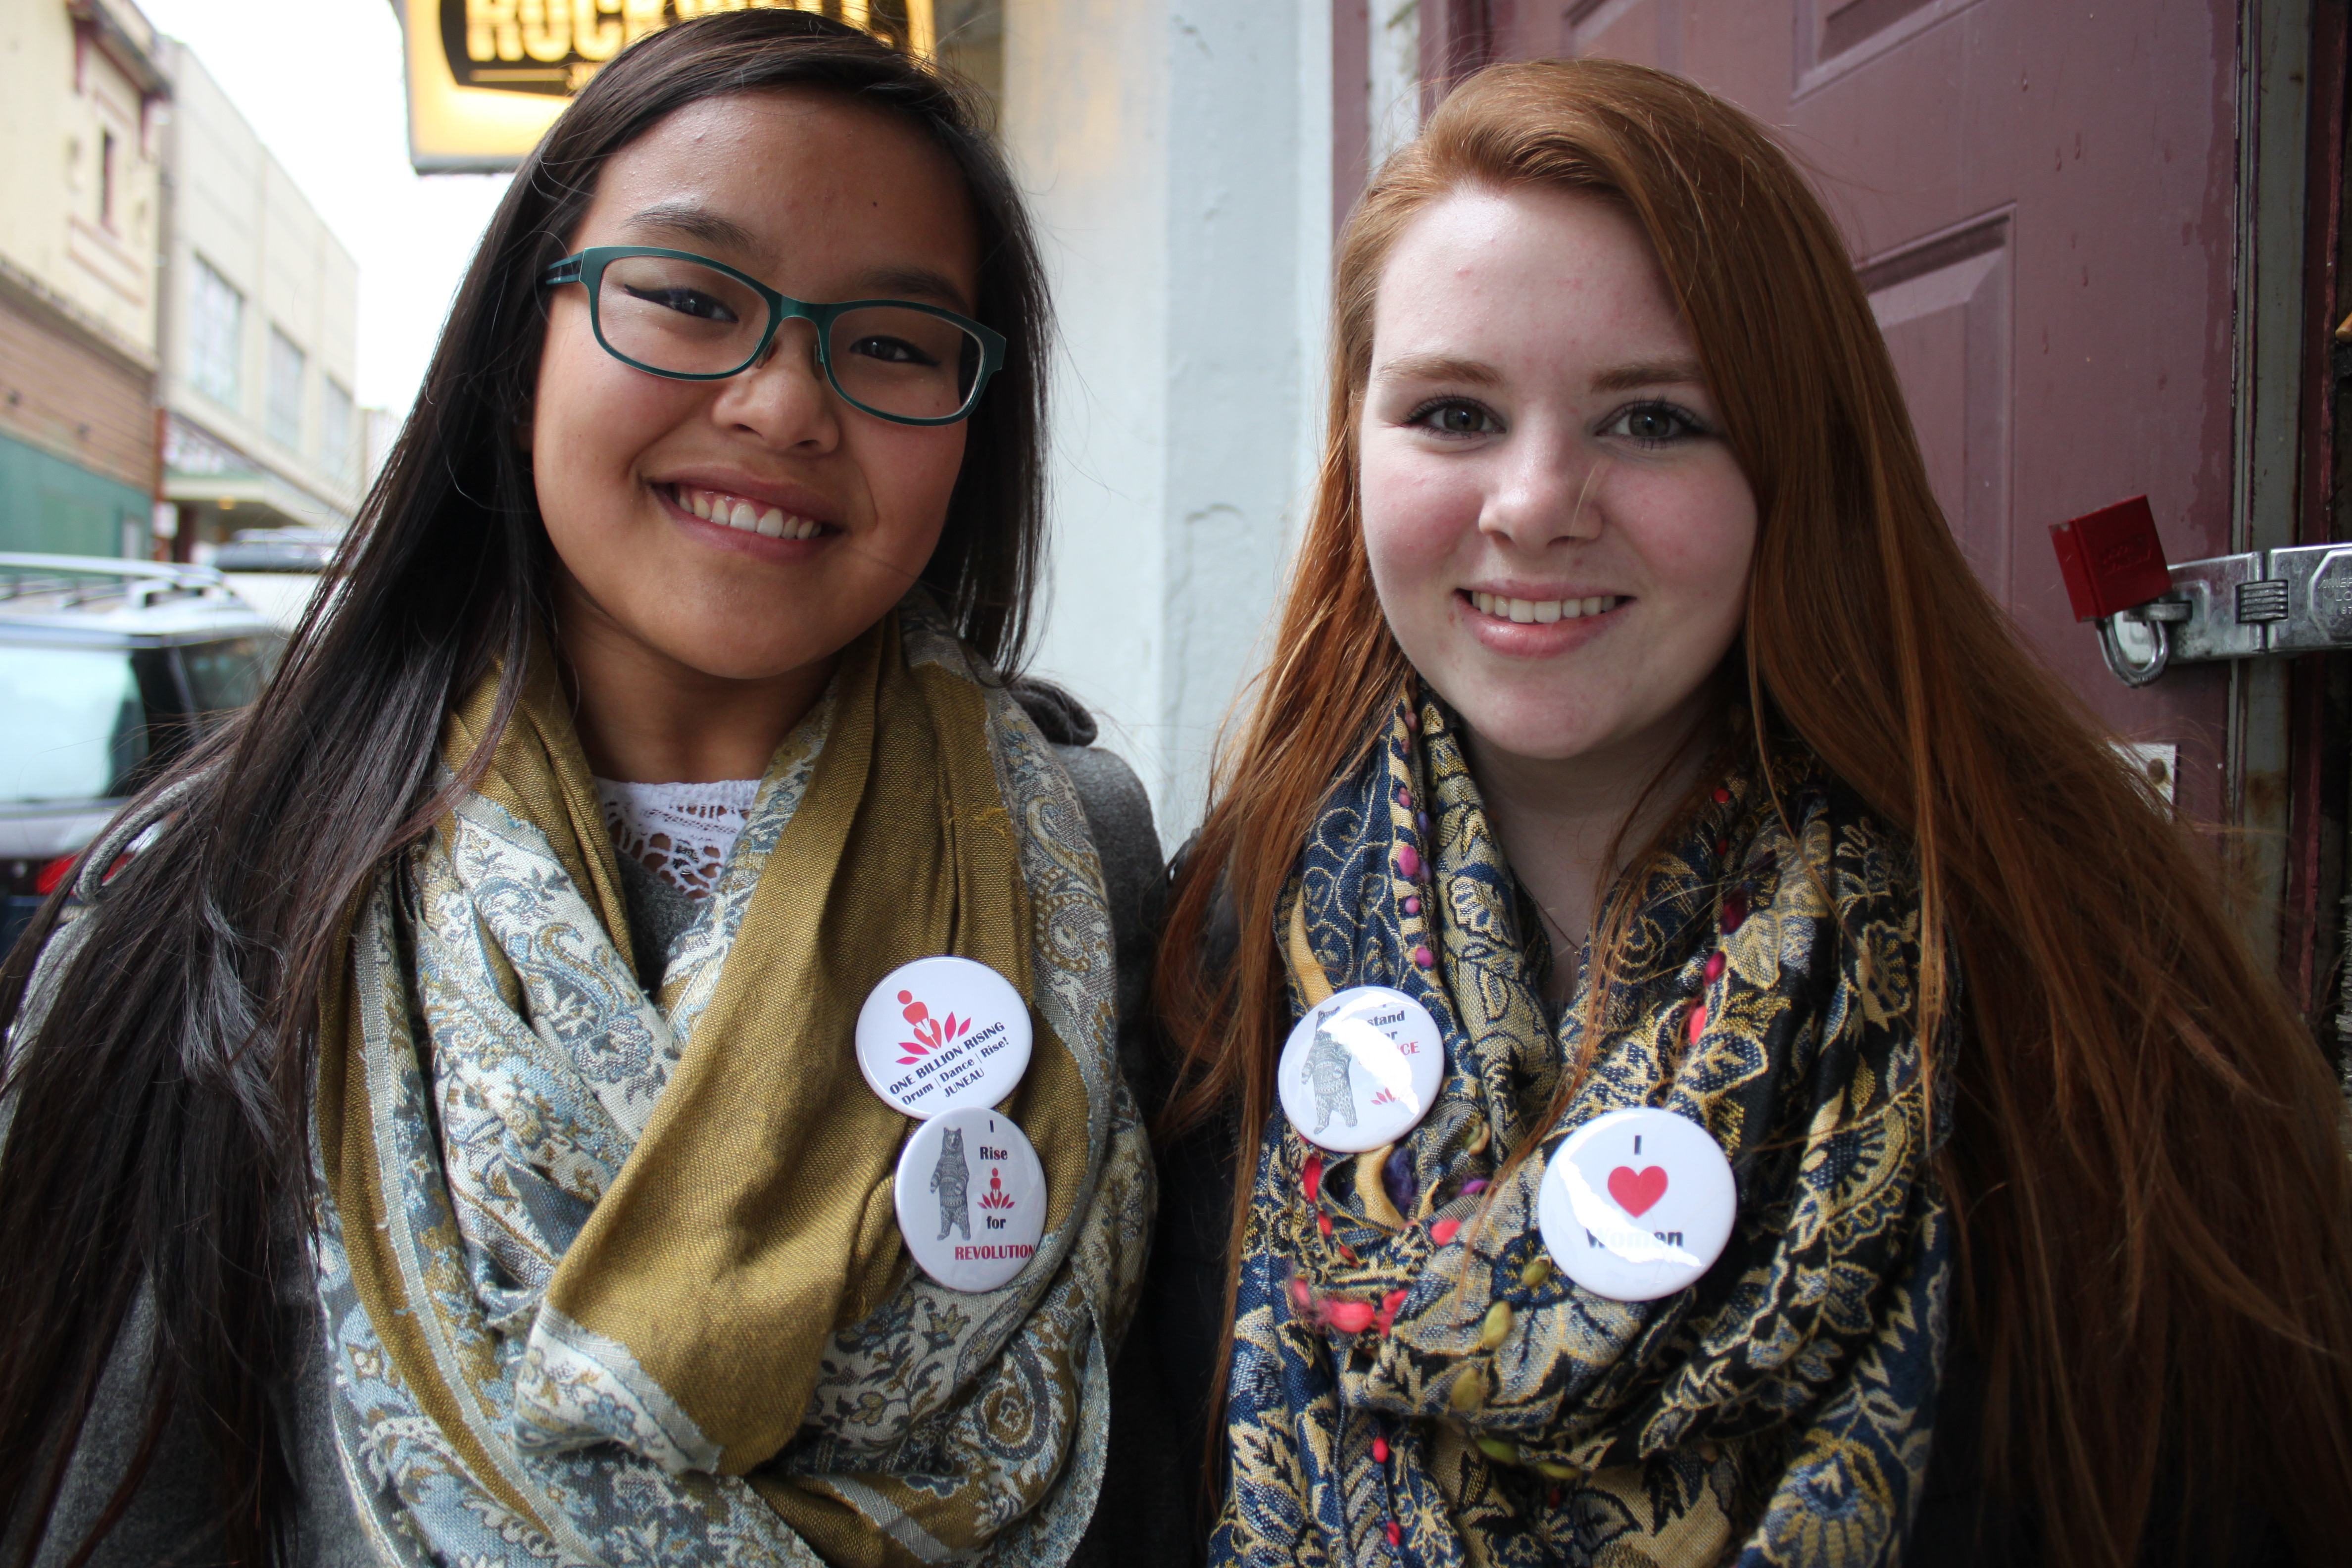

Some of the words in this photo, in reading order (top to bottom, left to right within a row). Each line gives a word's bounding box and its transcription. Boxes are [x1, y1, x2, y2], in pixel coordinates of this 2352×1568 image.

[889, 1074, 916, 1095] ONE
[915, 1045, 963, 1079] BILLION
[964, 1022, 1005, 1050] RISING
[901, 1083, 933, 1105] Drum
[939, 1058, 975, 1082] Dance
[980, 1036, 1009, 1058] Rise!
[944, 1068, 984, 1098] JUNEAU
[989, 1120, 994, 1133] I
[980, 1146, 1008, 1160] Rise
[1634, 1135, 1642, 1155] I
[986, 1216, 1006, 1229] for
[955, 1244, 1035, 1260] REVOLUTION
